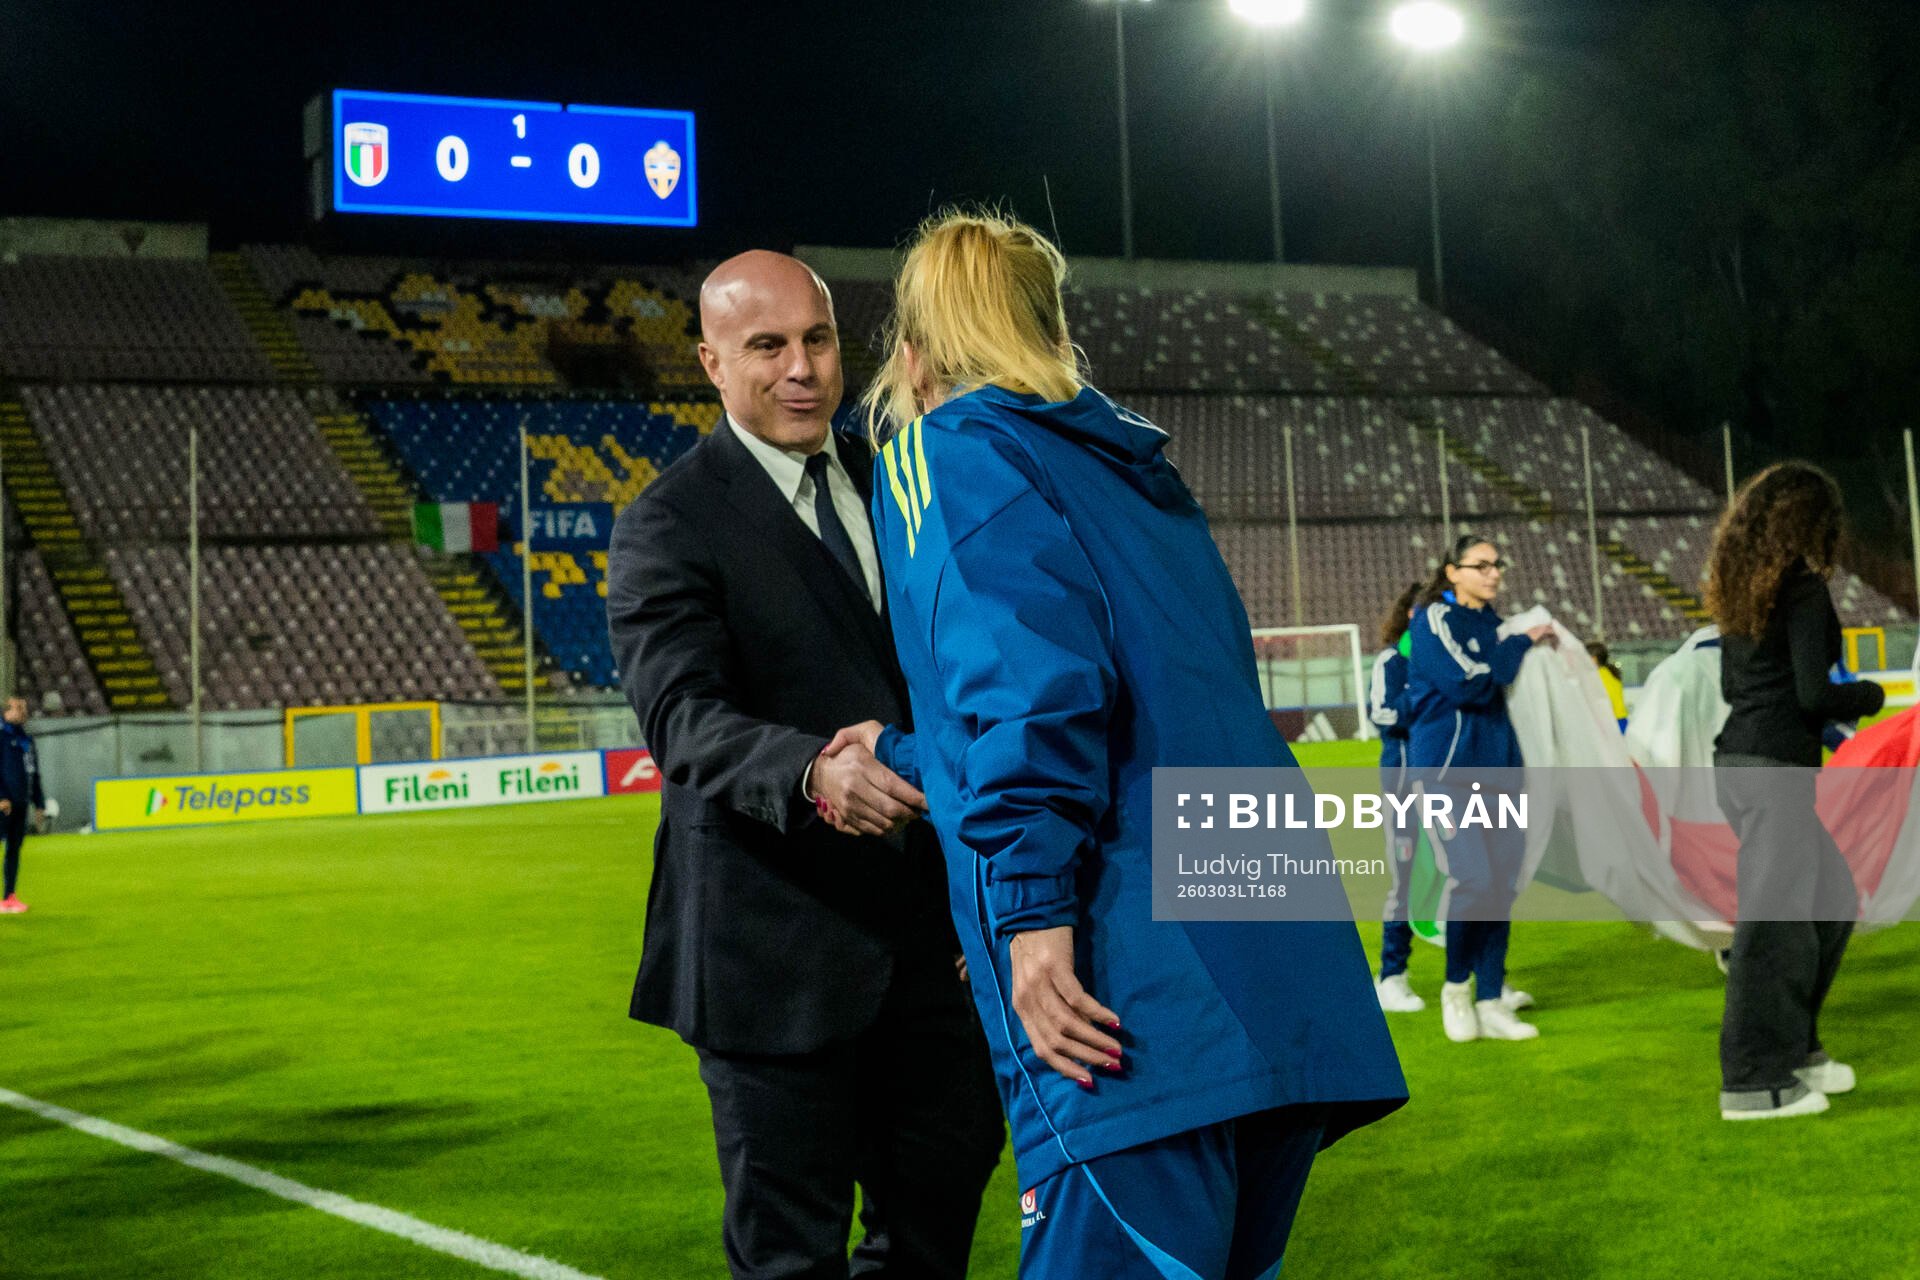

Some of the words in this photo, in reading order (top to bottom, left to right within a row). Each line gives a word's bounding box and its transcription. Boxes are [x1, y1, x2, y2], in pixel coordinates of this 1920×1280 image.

[511, 114, 526, 139] 1
[436, 135, 469, 182] 0
[568, 143, 600, 189] 0
[528, 509, 597, 538] FIFA
[174, 783, 310, 813] Telepass
[385, 773, 469, 803] Fileni
[499, 765, 580, 796] Fileni
